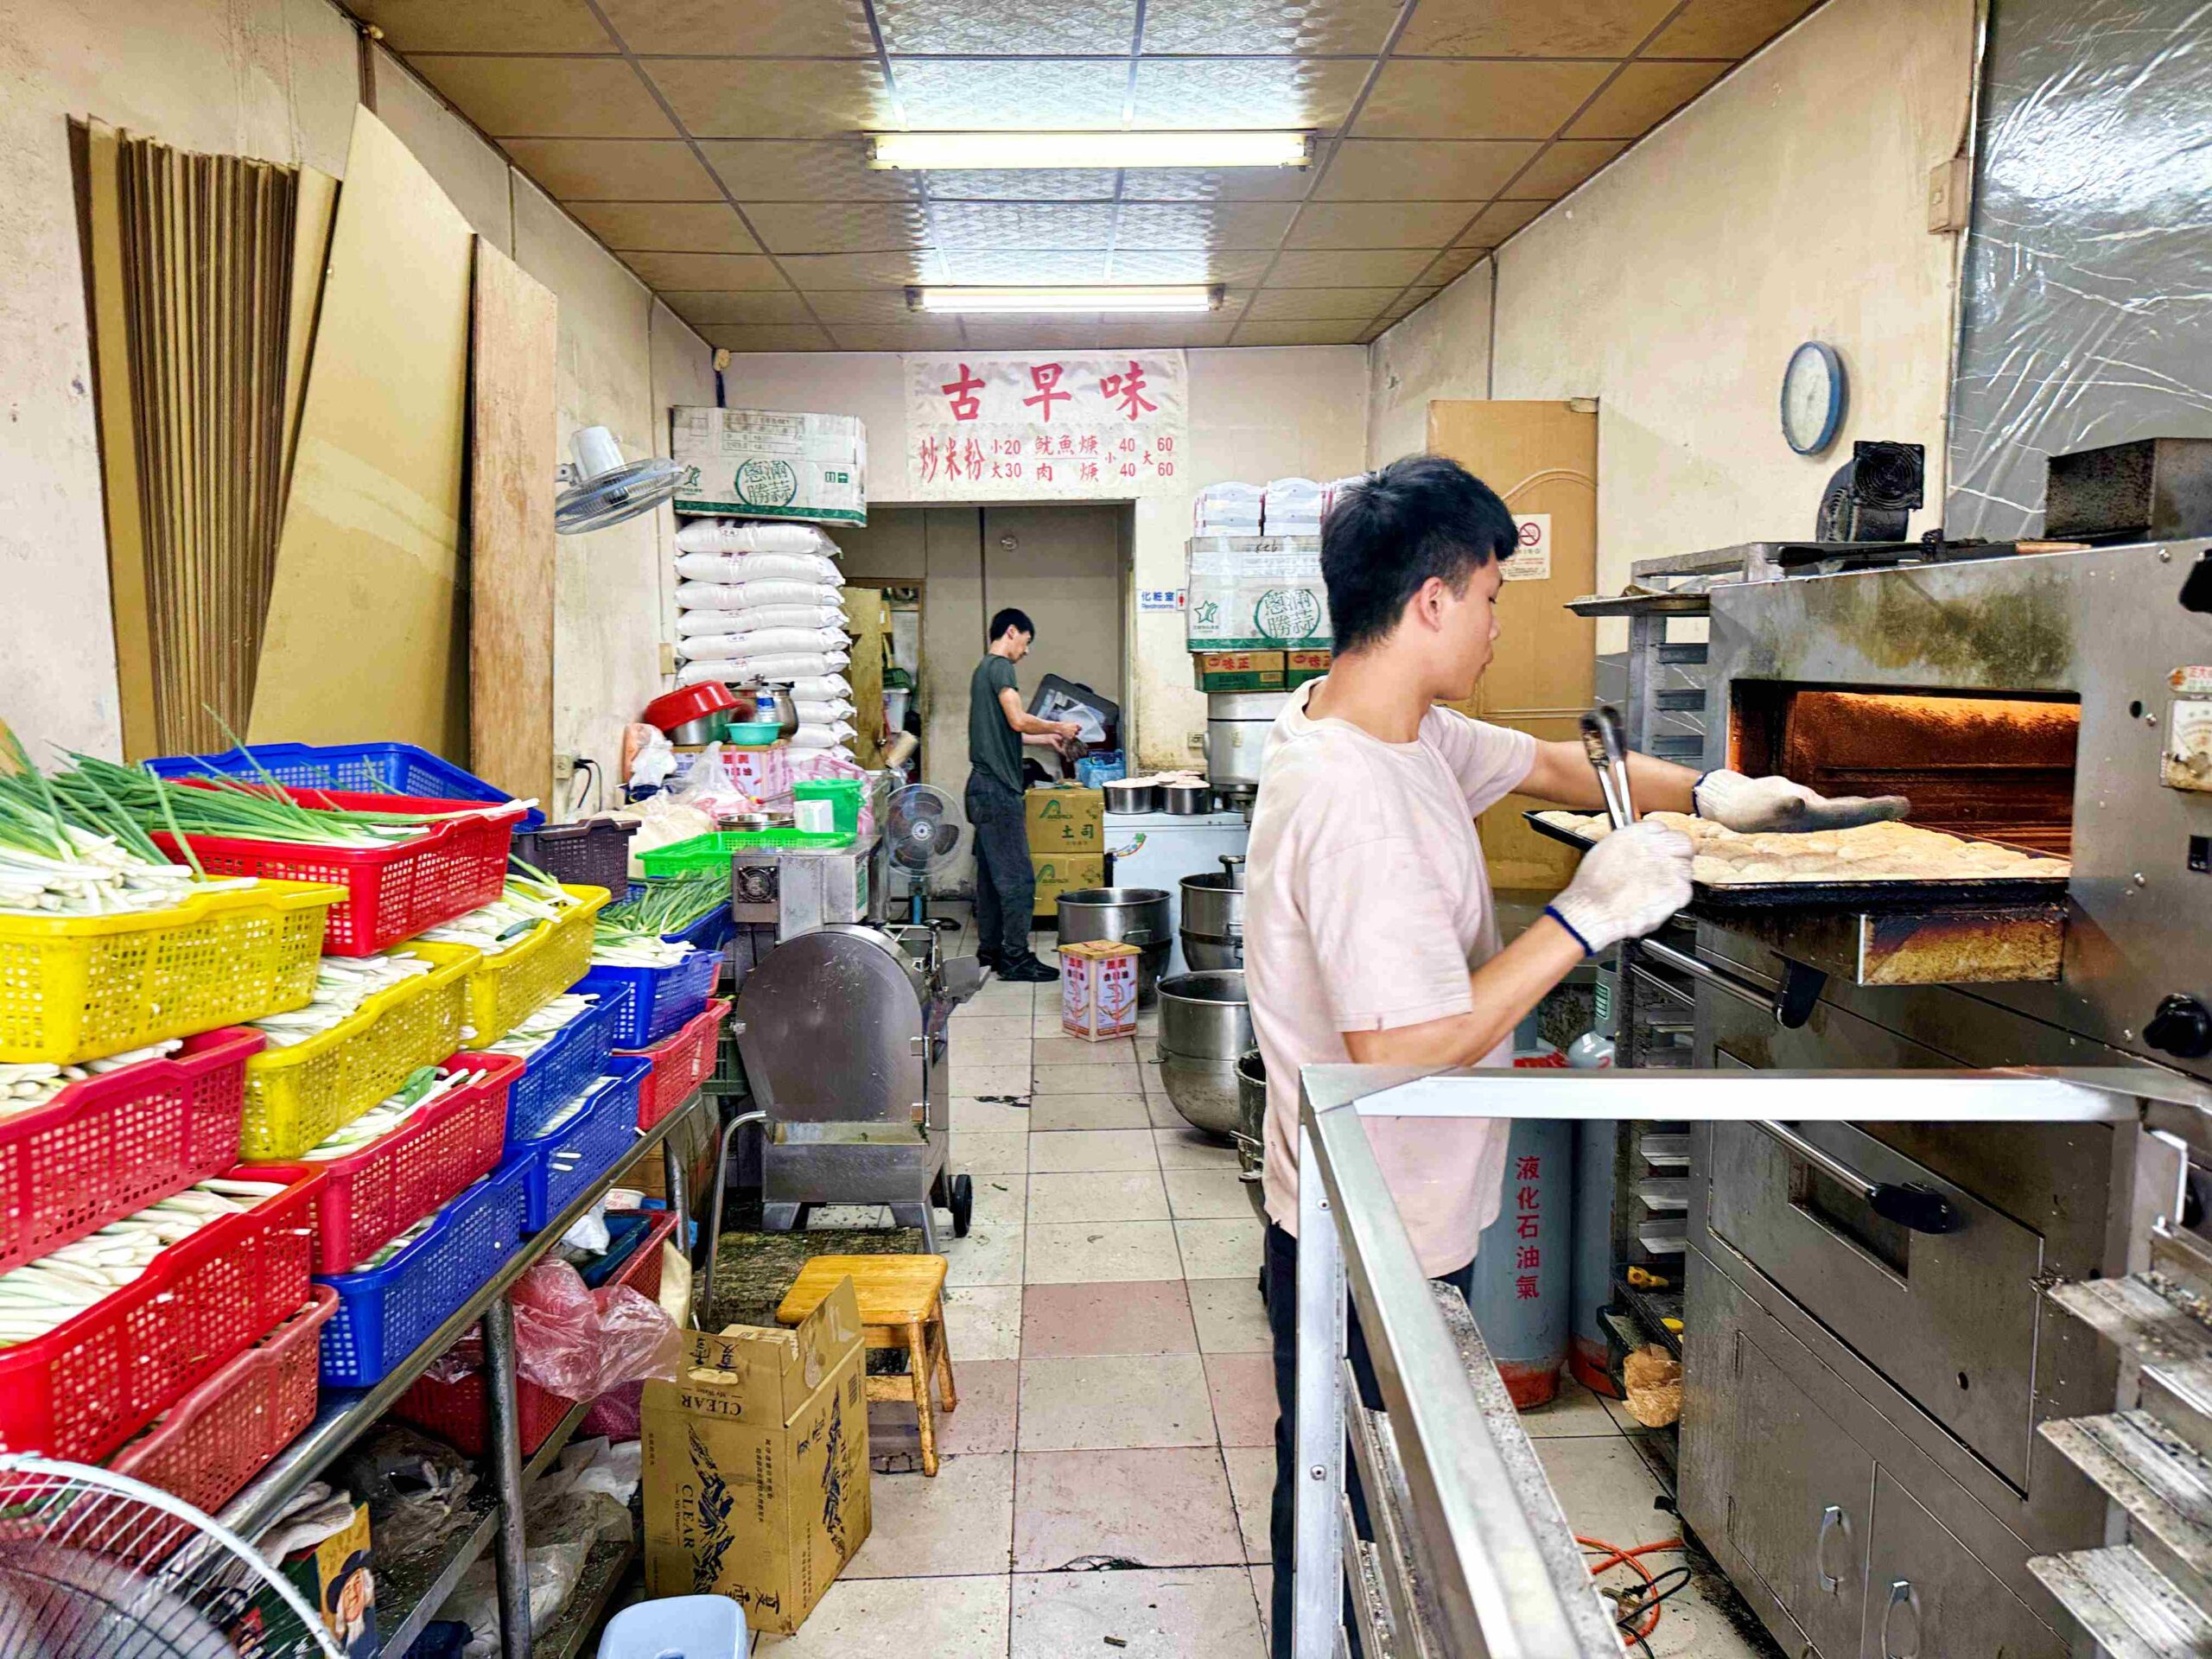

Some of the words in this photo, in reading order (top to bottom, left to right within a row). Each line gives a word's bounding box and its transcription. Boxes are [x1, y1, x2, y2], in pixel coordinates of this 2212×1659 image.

[941, 360, 1158, 423] 古早味
[919, 435, 986, 483] 炒米粉
[1119, 437, 1135, 452] 40
[1157, 437, 1173, 452] 60
[1119, 462, 1135, 477] 40
[1158, 462, 1173, 477] 60
[1062, 824, 1094, 839] 土司
[1515, 1155, 1541, 1300] 液化石油氣
[681, 1395, 742, 1416] CLEAR
[681, 1484, 695, 1549] CLEAR
